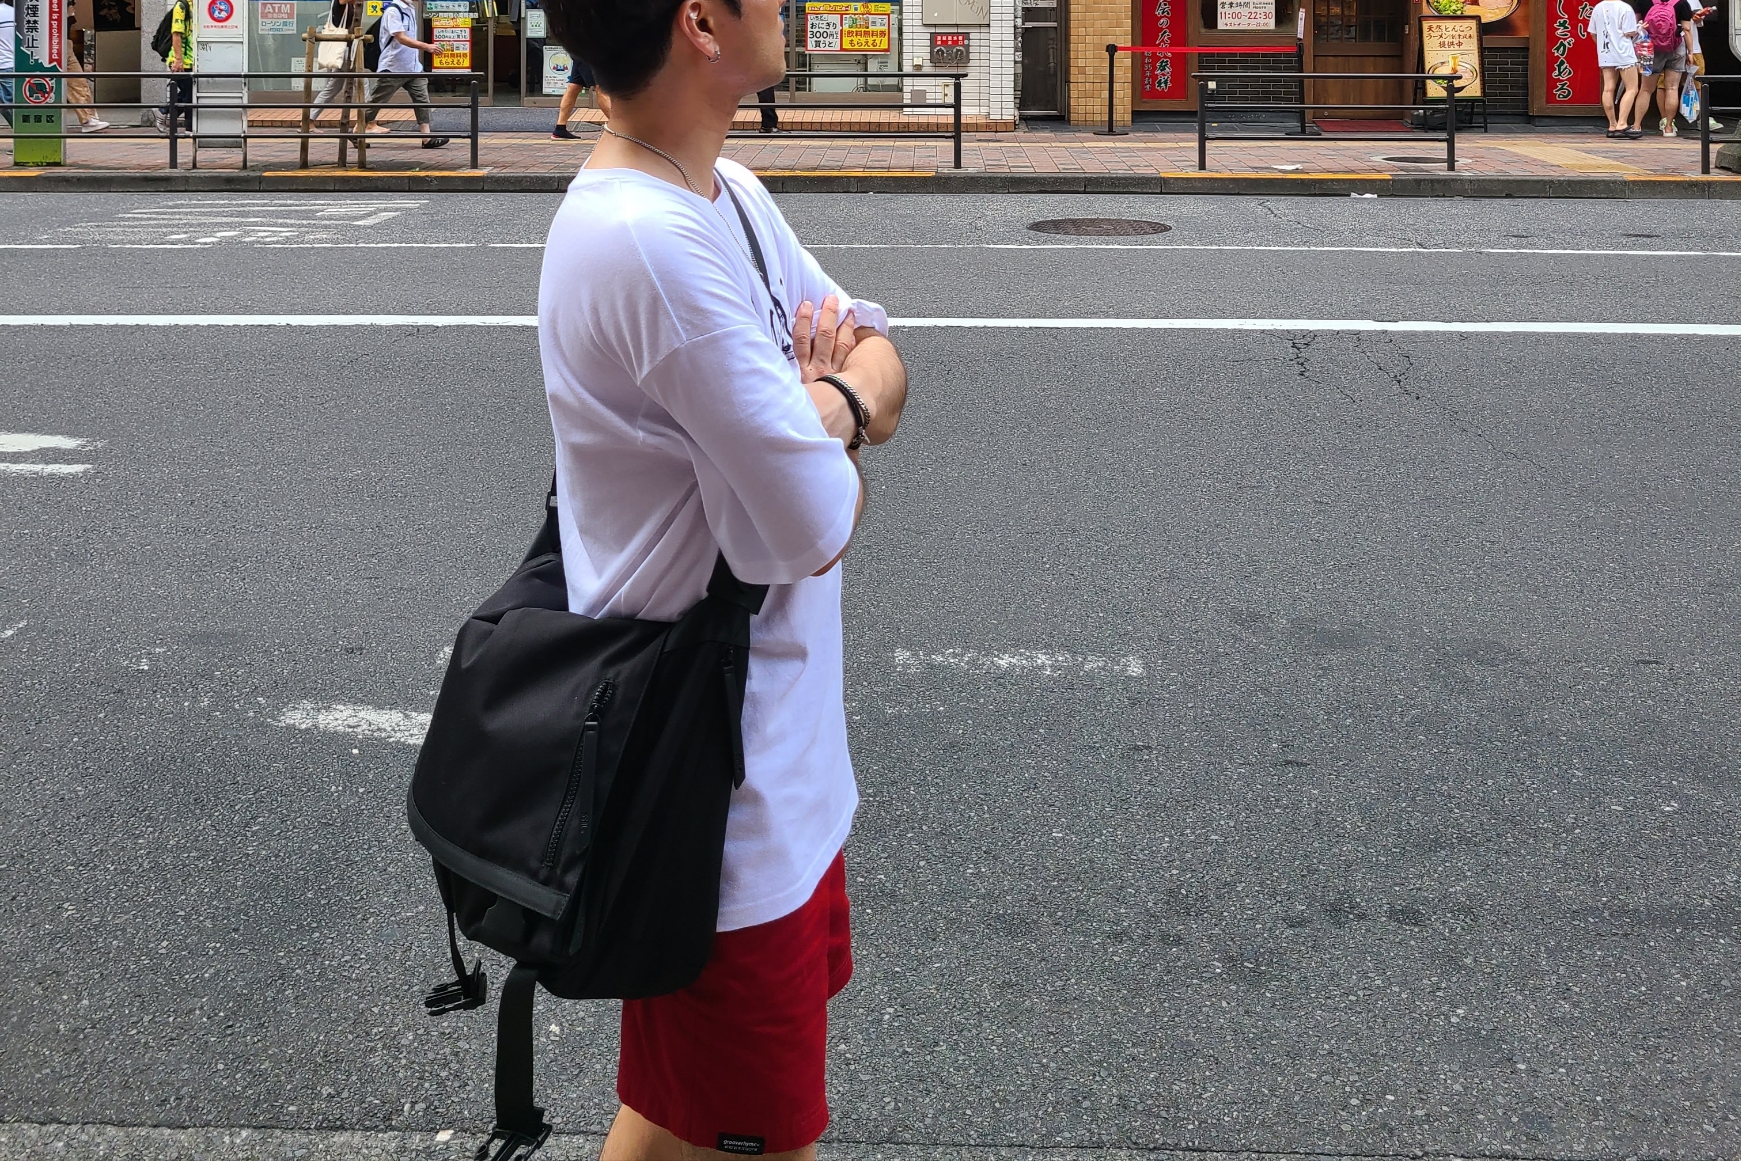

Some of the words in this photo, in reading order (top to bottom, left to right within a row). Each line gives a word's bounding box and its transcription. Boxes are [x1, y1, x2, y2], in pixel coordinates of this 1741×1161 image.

[264, 4, 291, 13] ATM
[810, 22, 837, 30] おにぎり
[1427, 24, 1473, 33] 天然とんこつ
[51, 20, 60, 60] prohibited
[1438, 40, 1464, 49] 提供中
